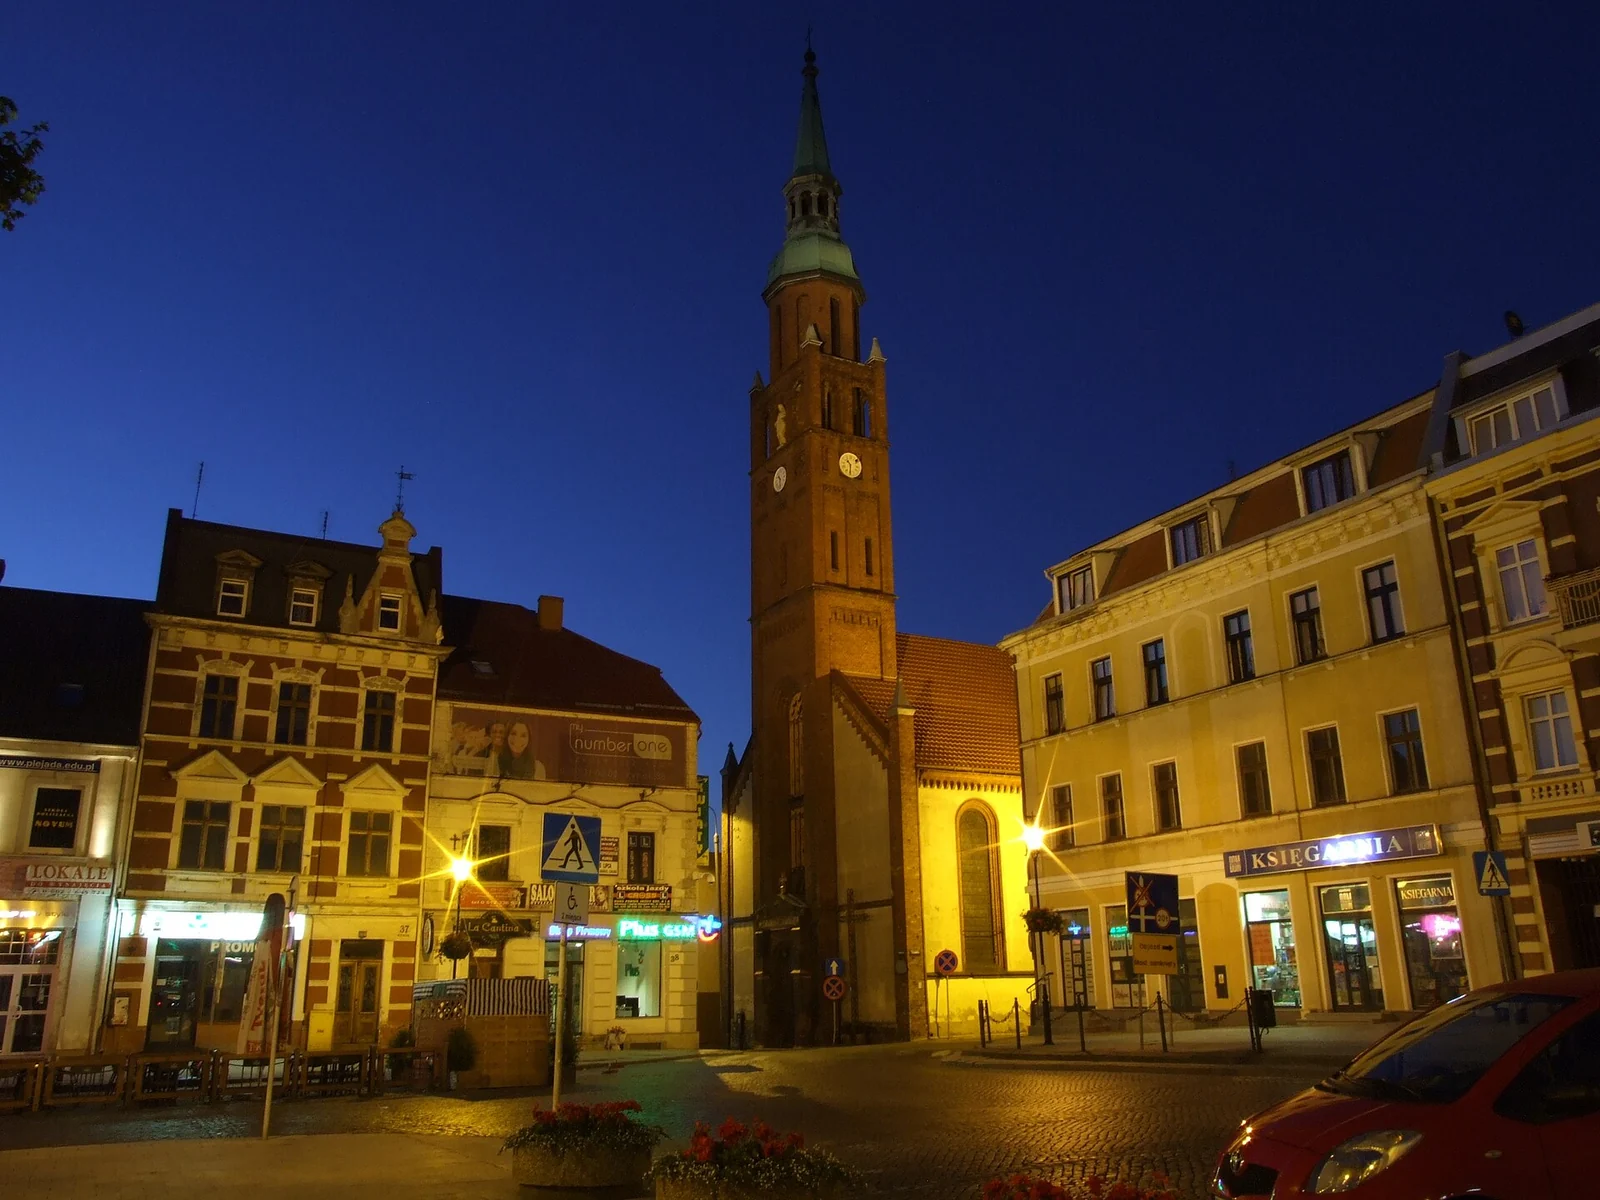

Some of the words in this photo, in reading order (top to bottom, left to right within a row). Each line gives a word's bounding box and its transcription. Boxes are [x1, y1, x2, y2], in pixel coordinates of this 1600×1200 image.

[574, 737, 633, 753] number
[637, 741, 668, 753] one
[32, 864, 108, 880] LOKALE
[530, 884, 555, 901] SALO
[399, 925, 410, 933] 37
[468, 921, 479, 932] La
[482, 920, 519, 932] Cantina
[619, 919, 659, 937] Plus
[663, 923, 696, 938] GSM
[210, 941, 258, 953] PROM
[625, 964, 640, 977] Plus
